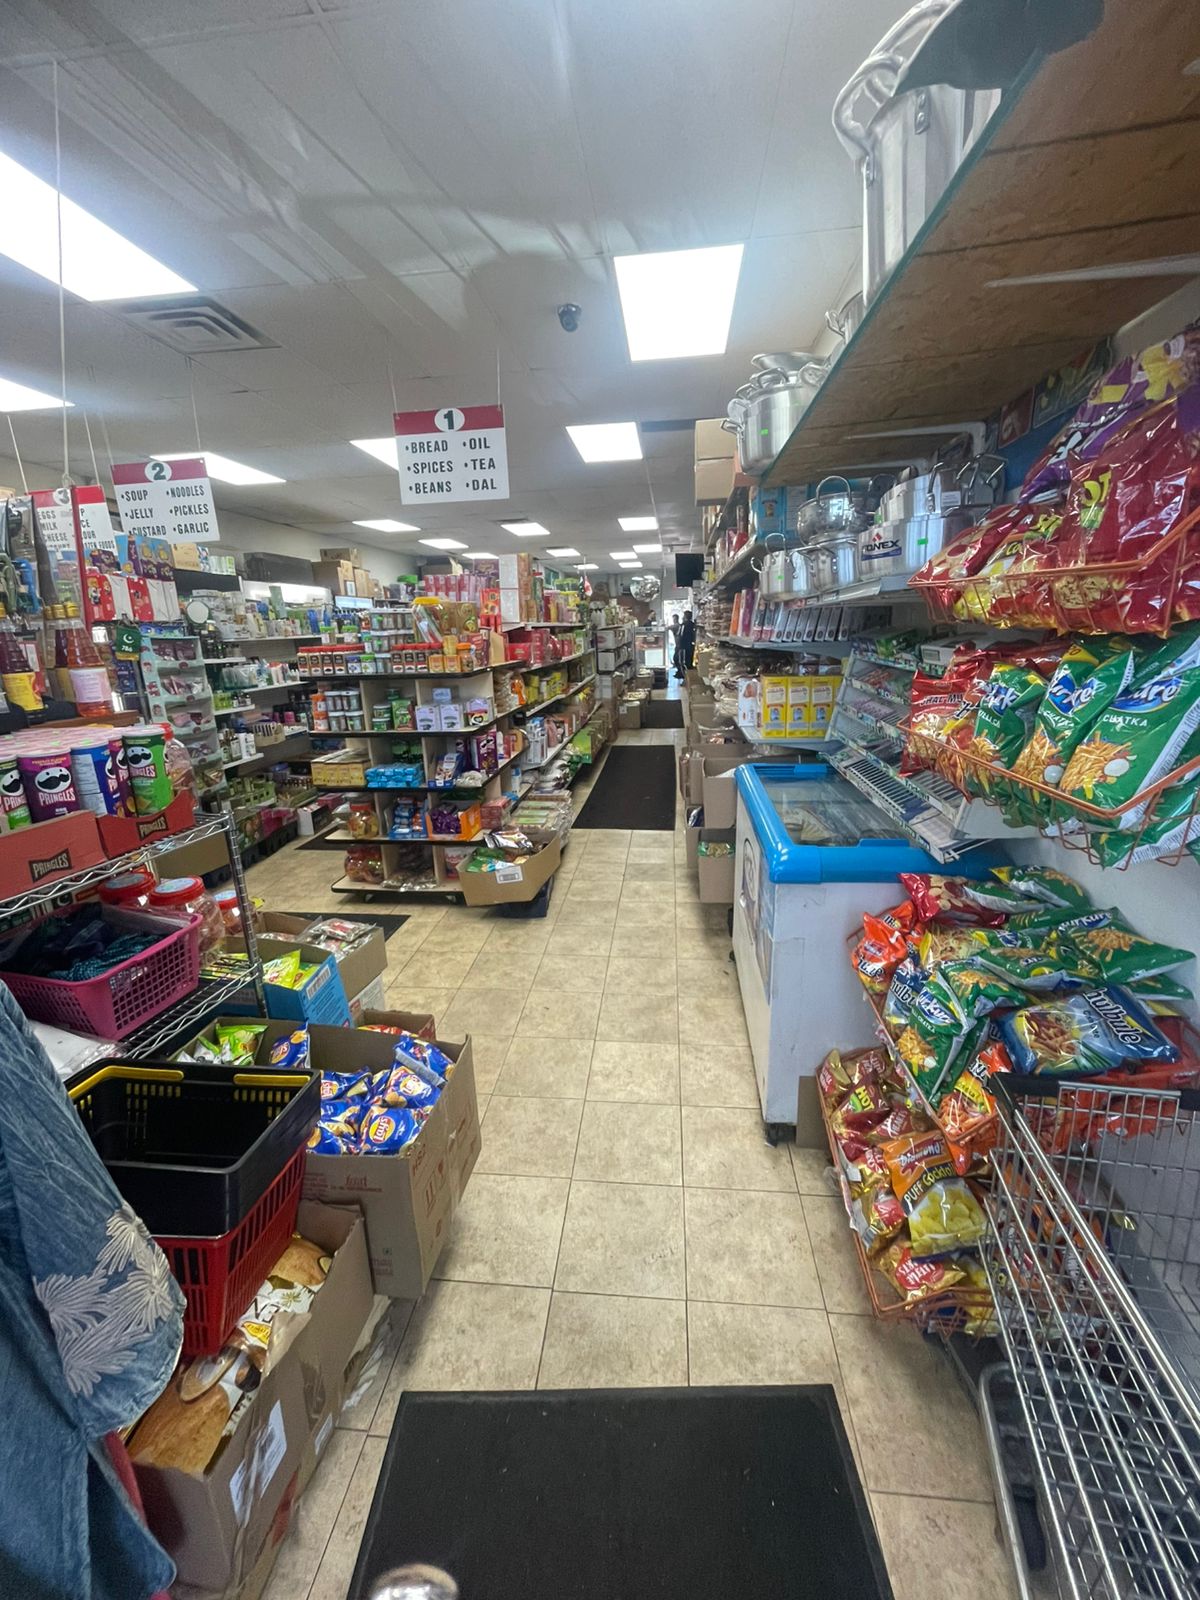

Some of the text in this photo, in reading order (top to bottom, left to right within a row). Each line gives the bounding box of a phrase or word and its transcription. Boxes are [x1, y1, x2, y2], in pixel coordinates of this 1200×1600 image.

[444, 410, 454, 430] 1
[411, 437, 490, 454] BREAD OIL
[152, 462, 166, 481] 2
[413, 457, 496, 474] SPICES TEA
[125, 485, 205, 501] SOUP NOODLES
[415, 478, 497, 494] BEANS DAL
[58, 488, 70, 505] 3
[129, 503, 209, 520] JELLY PICKLES
[132, 522, 209, 537] CUSTARD GARLIC
[1103, 714, 1148, 727] CHATKA
[38, 786, 76, 806] PRINGLES
[32, 852, 69, 879] PRINGLES
[854, 1084, 875, 1112] HOT
[903, 1180, 924, 1205] PUFF
